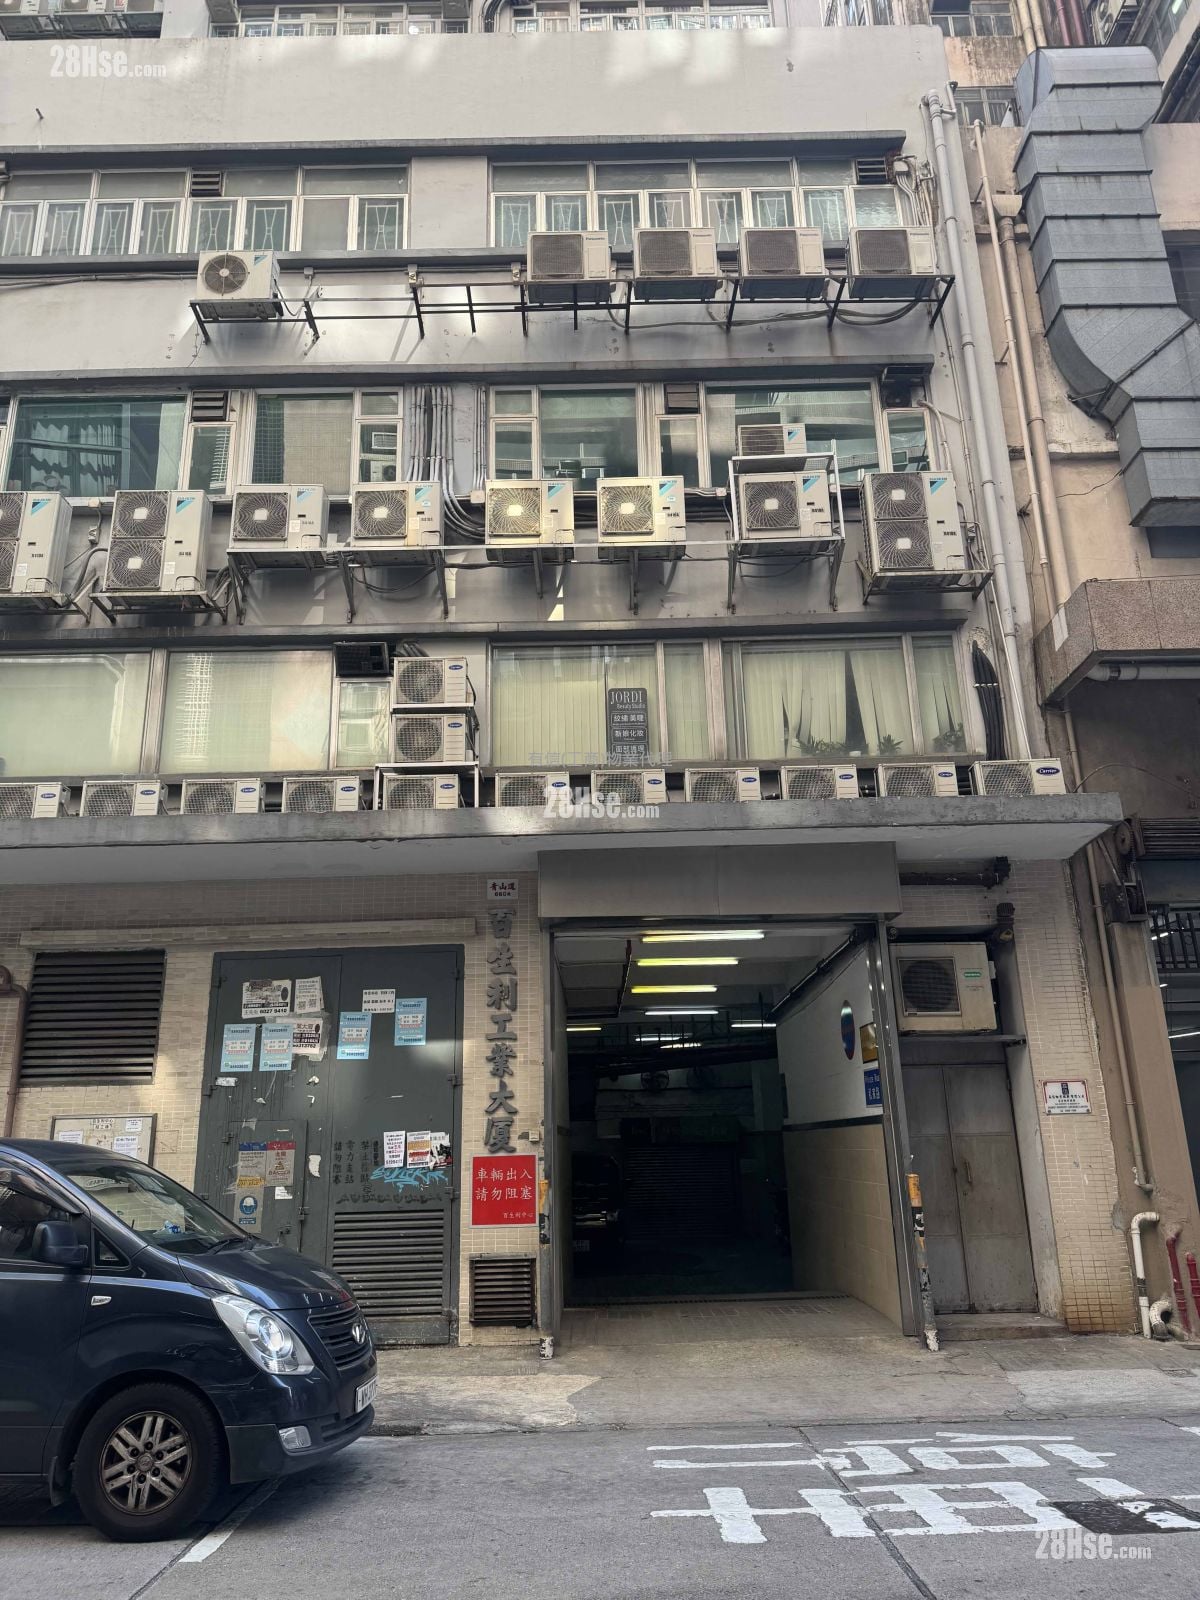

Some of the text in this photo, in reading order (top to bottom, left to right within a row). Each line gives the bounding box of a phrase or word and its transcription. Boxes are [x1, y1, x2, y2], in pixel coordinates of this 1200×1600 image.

[610, 691, 643, 704] JORDI
[1037, 767, 1060, 775] Carrier
[489, 882, 516, 891] 青山道
[475, 1167, 533, 1183] 車輛出入
[475, 1185, 533, 1201] 請勿阻塞
